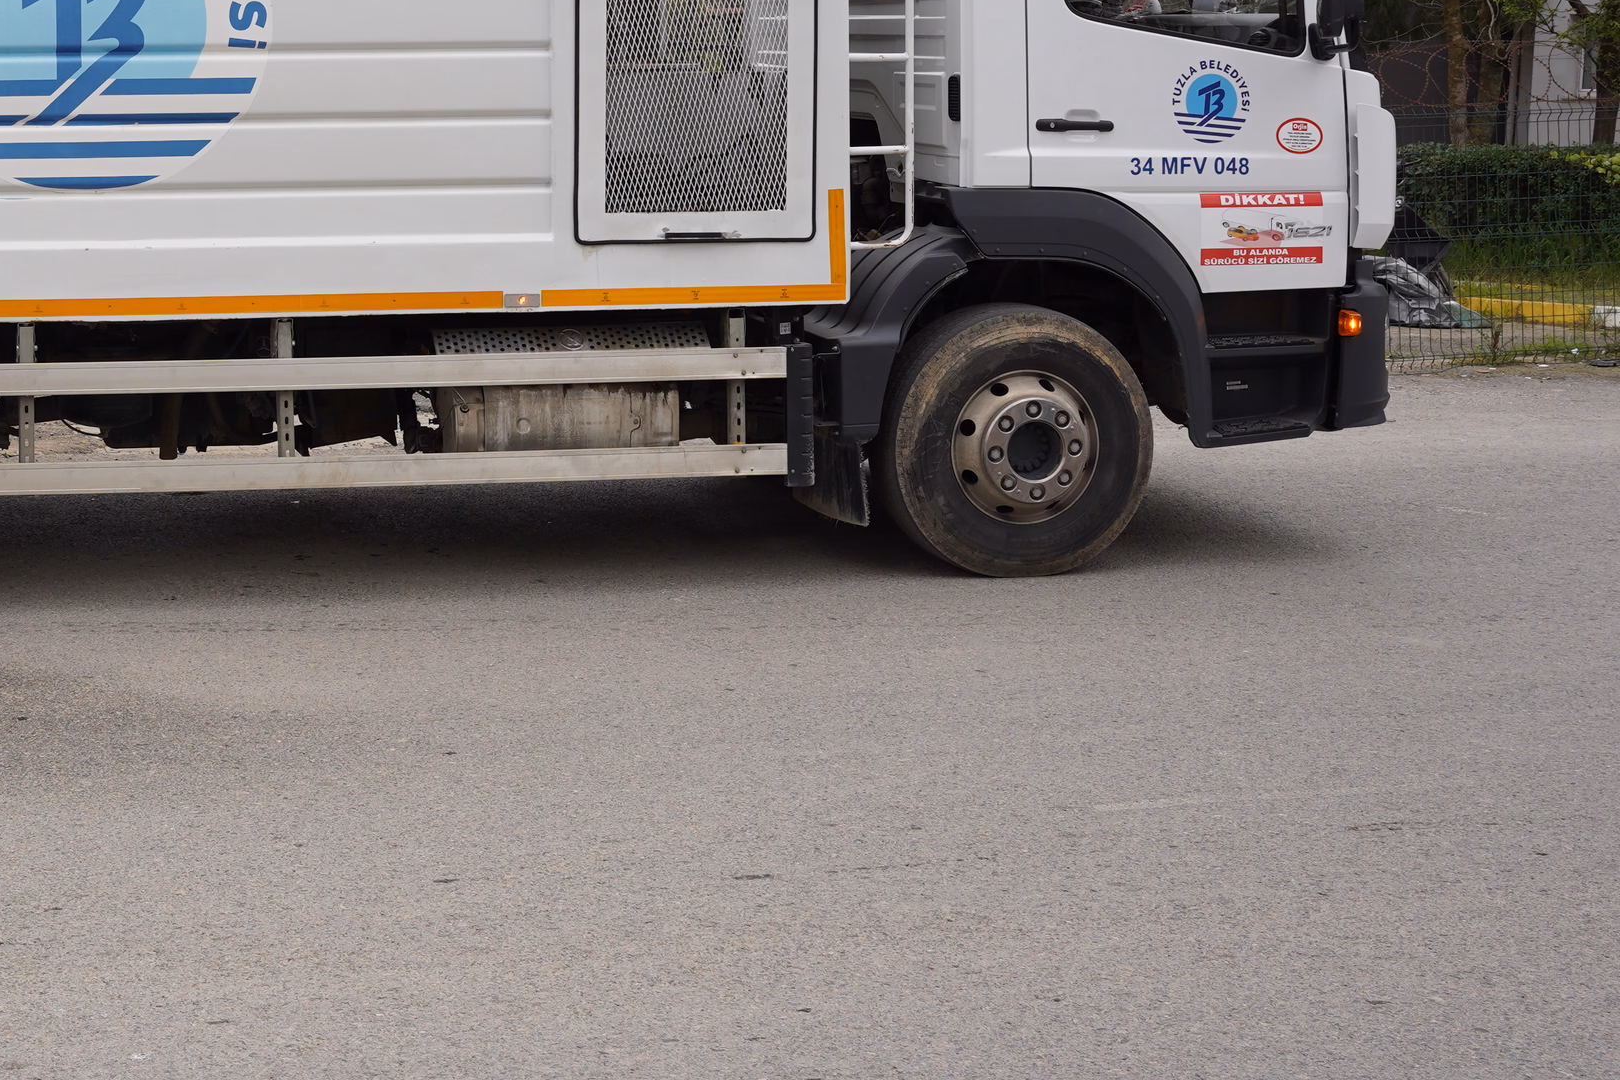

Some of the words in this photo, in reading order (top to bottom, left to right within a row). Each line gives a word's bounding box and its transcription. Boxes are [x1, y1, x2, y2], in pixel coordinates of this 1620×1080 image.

[1172, 66, 1198, 106] TUZLA
[1130, 157, 1154, 176] 34
[1161, 157, 1208, 175] MFV
[1214, 157, 1250, 176] 048
[1219, 193, 1305, 206] DİKKAT!
[1269, 256, 1317, 264] GÖREMEZ
